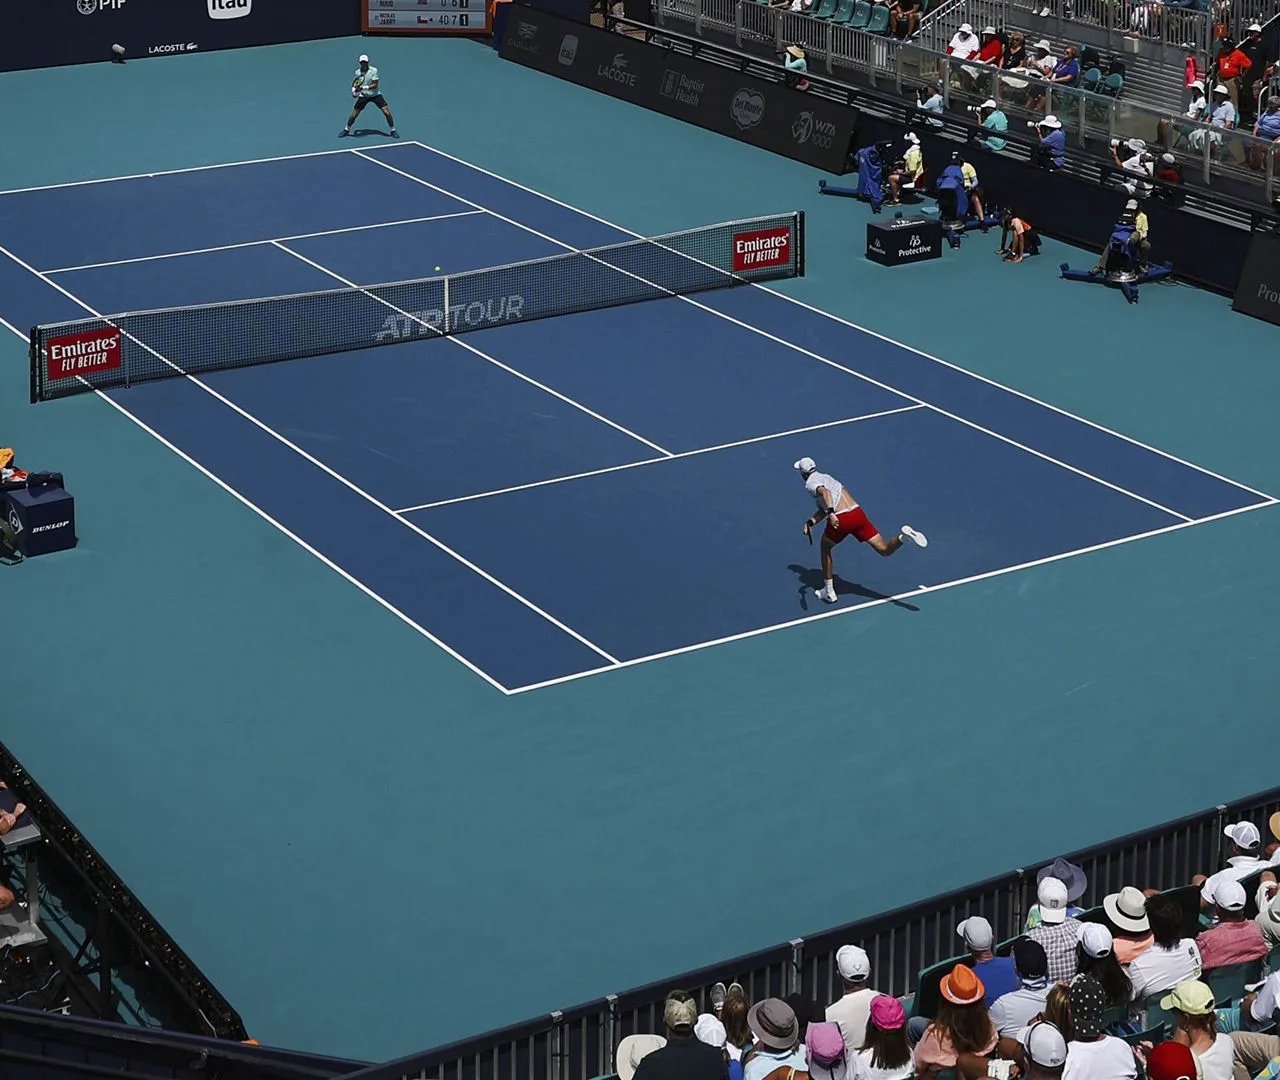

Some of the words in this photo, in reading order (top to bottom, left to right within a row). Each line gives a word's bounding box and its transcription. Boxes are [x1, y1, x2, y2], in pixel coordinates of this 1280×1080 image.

[439, 15, 449, 25] 40
[452, 15, 457, 25] 7
[149, 43, 185, 54] LACOSTE
[597, 64, 636, 87] LACOSTE
[679, 74, 705, 93] Baptist
[676, 88, 700, 107] Health
[815, 119, 836, 137] WTA
[812, 132, 832, 150] 1000
[736, 236, 787, 254] Emirates
[898, 245, 932, 257] Protective
[744, 253, 755, 264] FLY
[756, 249, 780, 260] BETTER
[448, 294, 524, 330] TOUR
[51, 337, 117, 360] Emirates
[62, 357, 76, 371] FLY
[77, 351, 108, 369] BETTER
[32, 520, 70, 534] DUNLOP
